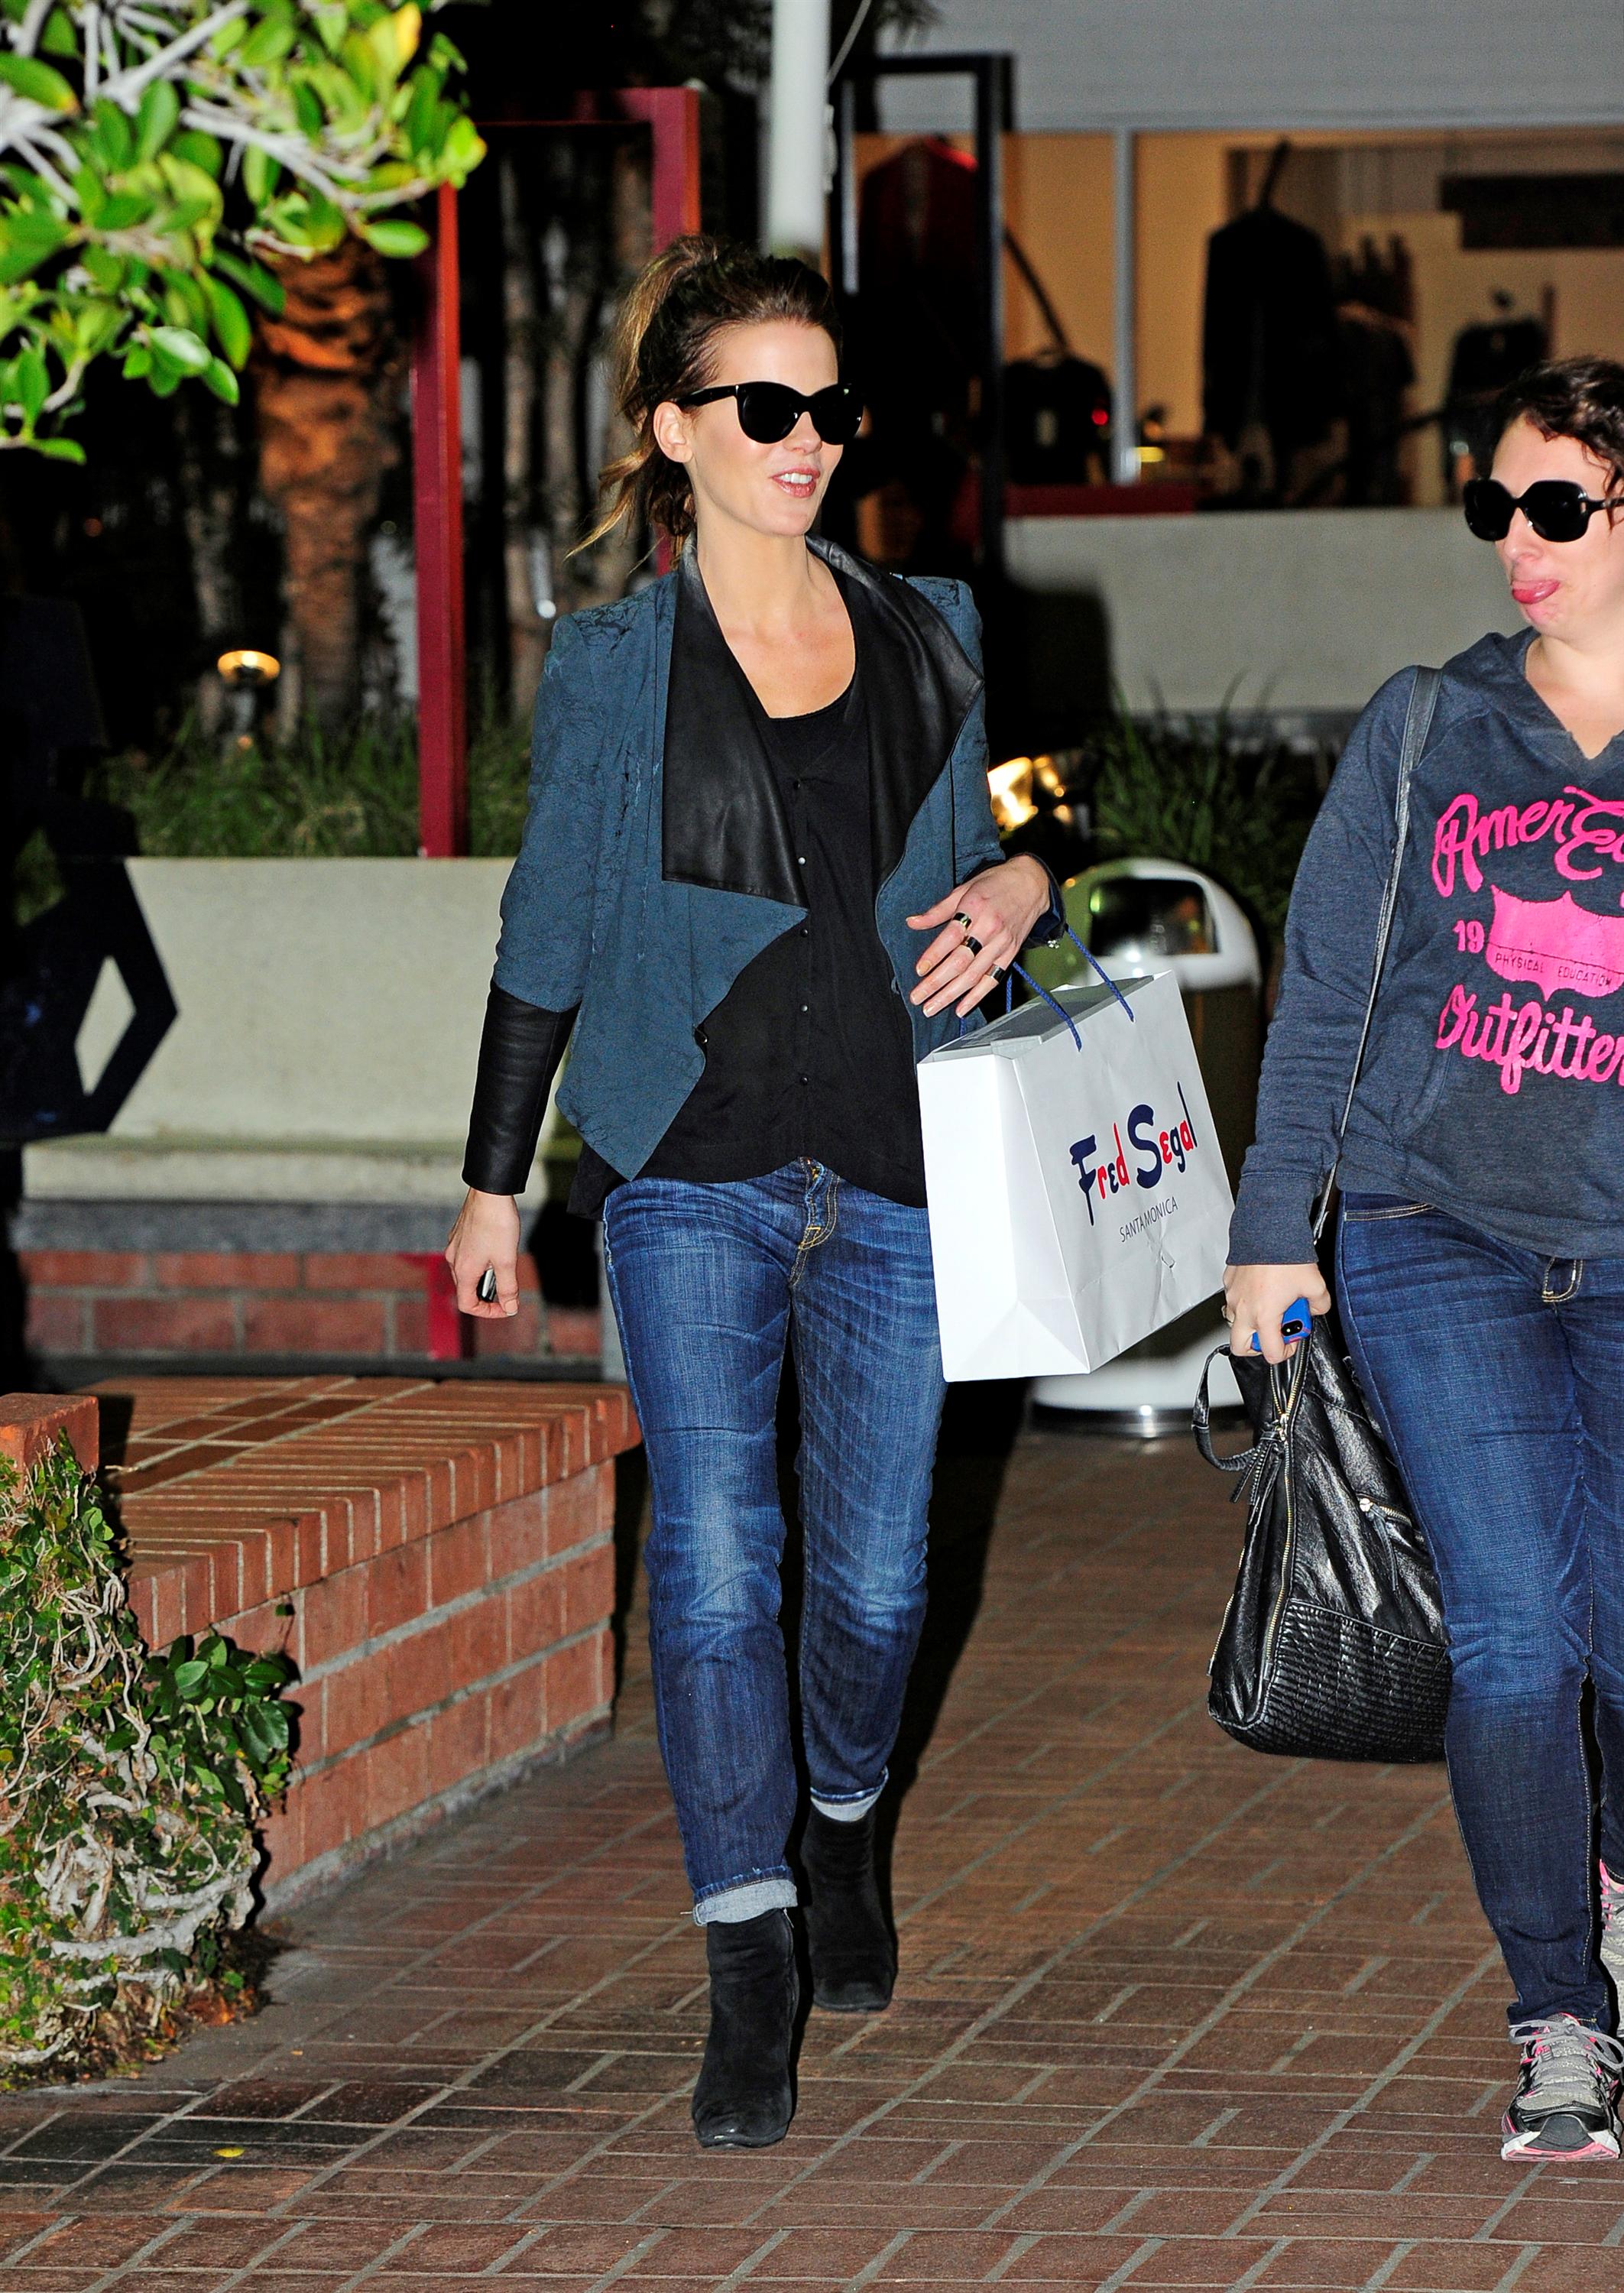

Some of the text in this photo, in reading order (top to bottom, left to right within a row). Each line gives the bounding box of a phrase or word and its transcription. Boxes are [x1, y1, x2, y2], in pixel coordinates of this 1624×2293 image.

[1454, 920, 1485, 954] 19
[1495, 952, 1612, 987] PHYSICAL EDUCATION
[1069, 1081, 1198, 1226] Fred Segal
